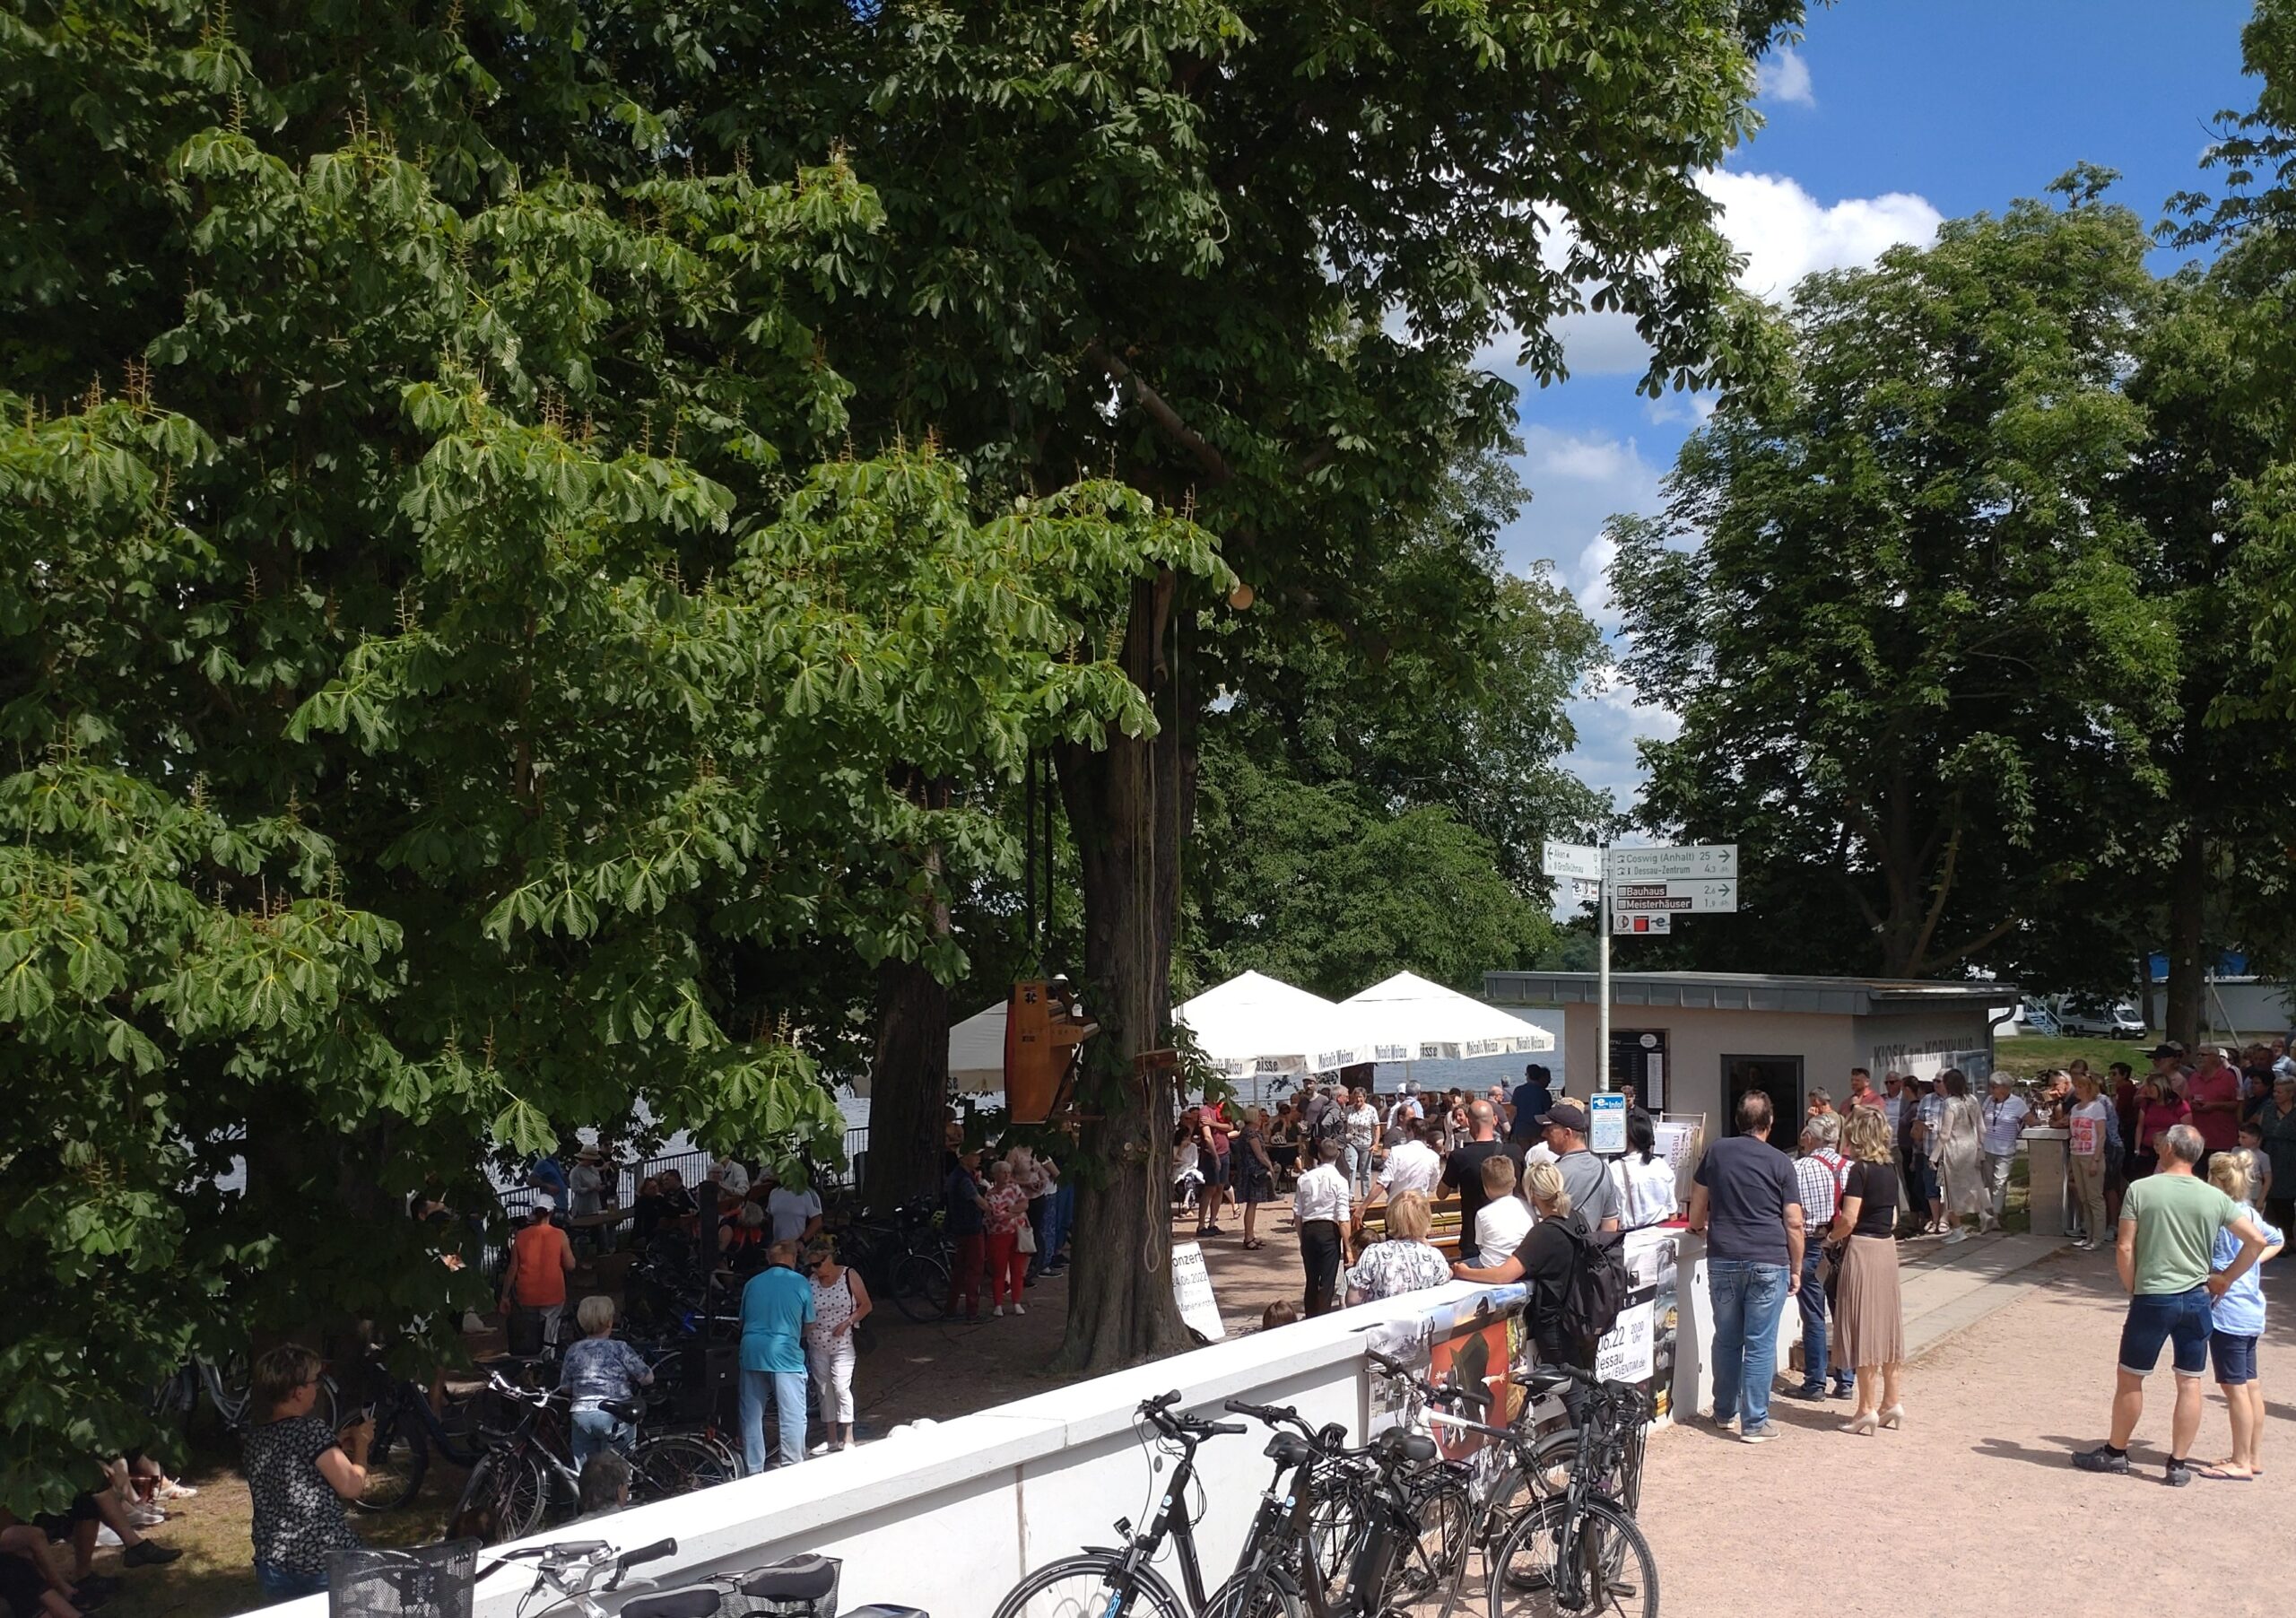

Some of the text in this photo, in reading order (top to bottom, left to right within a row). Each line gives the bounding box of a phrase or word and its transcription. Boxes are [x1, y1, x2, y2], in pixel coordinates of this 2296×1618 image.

[1626, 851, 1710, 864] Coswig (Anhalt) 25
[1634, 866, 1691, 875] Dessau-Zentrum
[1626, 887, 1665, 896] Bauhaus
[1626, 900, 1691, 909] Meisterhäuser
[1483, 1039, 1498, 1054] Weisse
[1874, 1036, 1973, 1067] KIOSK am KORNHAUS
[1256, 1057, 1278, 1072] eisse
[1337, 1049, 1354, 1065] Weisse
[1172, 1251, 1204, 1266] onzert
[1597, 1326, 1624, 1353] 06.22
[1631, 1334, 1641, 1344] Uhr
